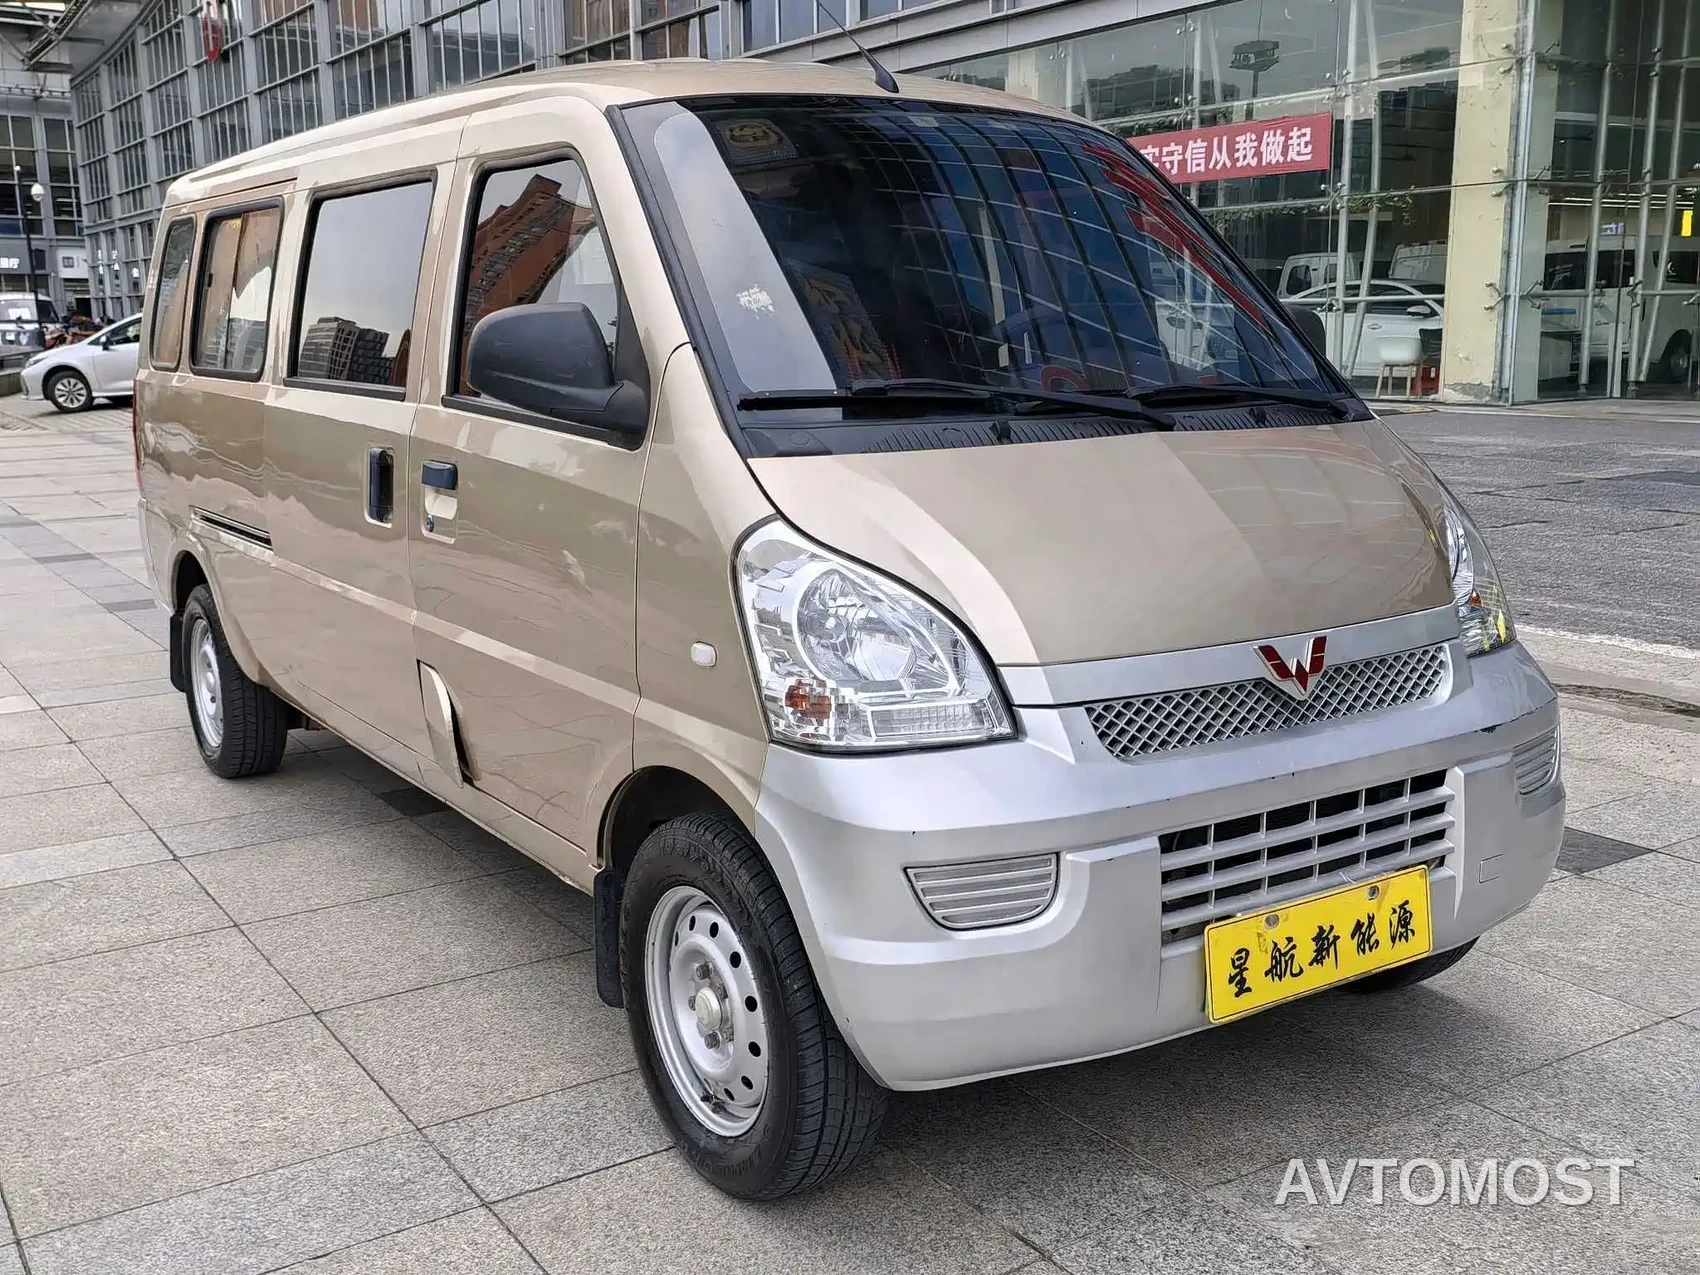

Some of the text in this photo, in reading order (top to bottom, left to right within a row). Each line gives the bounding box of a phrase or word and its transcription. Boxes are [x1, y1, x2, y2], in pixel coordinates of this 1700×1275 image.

[1228, 900, 1416, 998] 星航新能源
